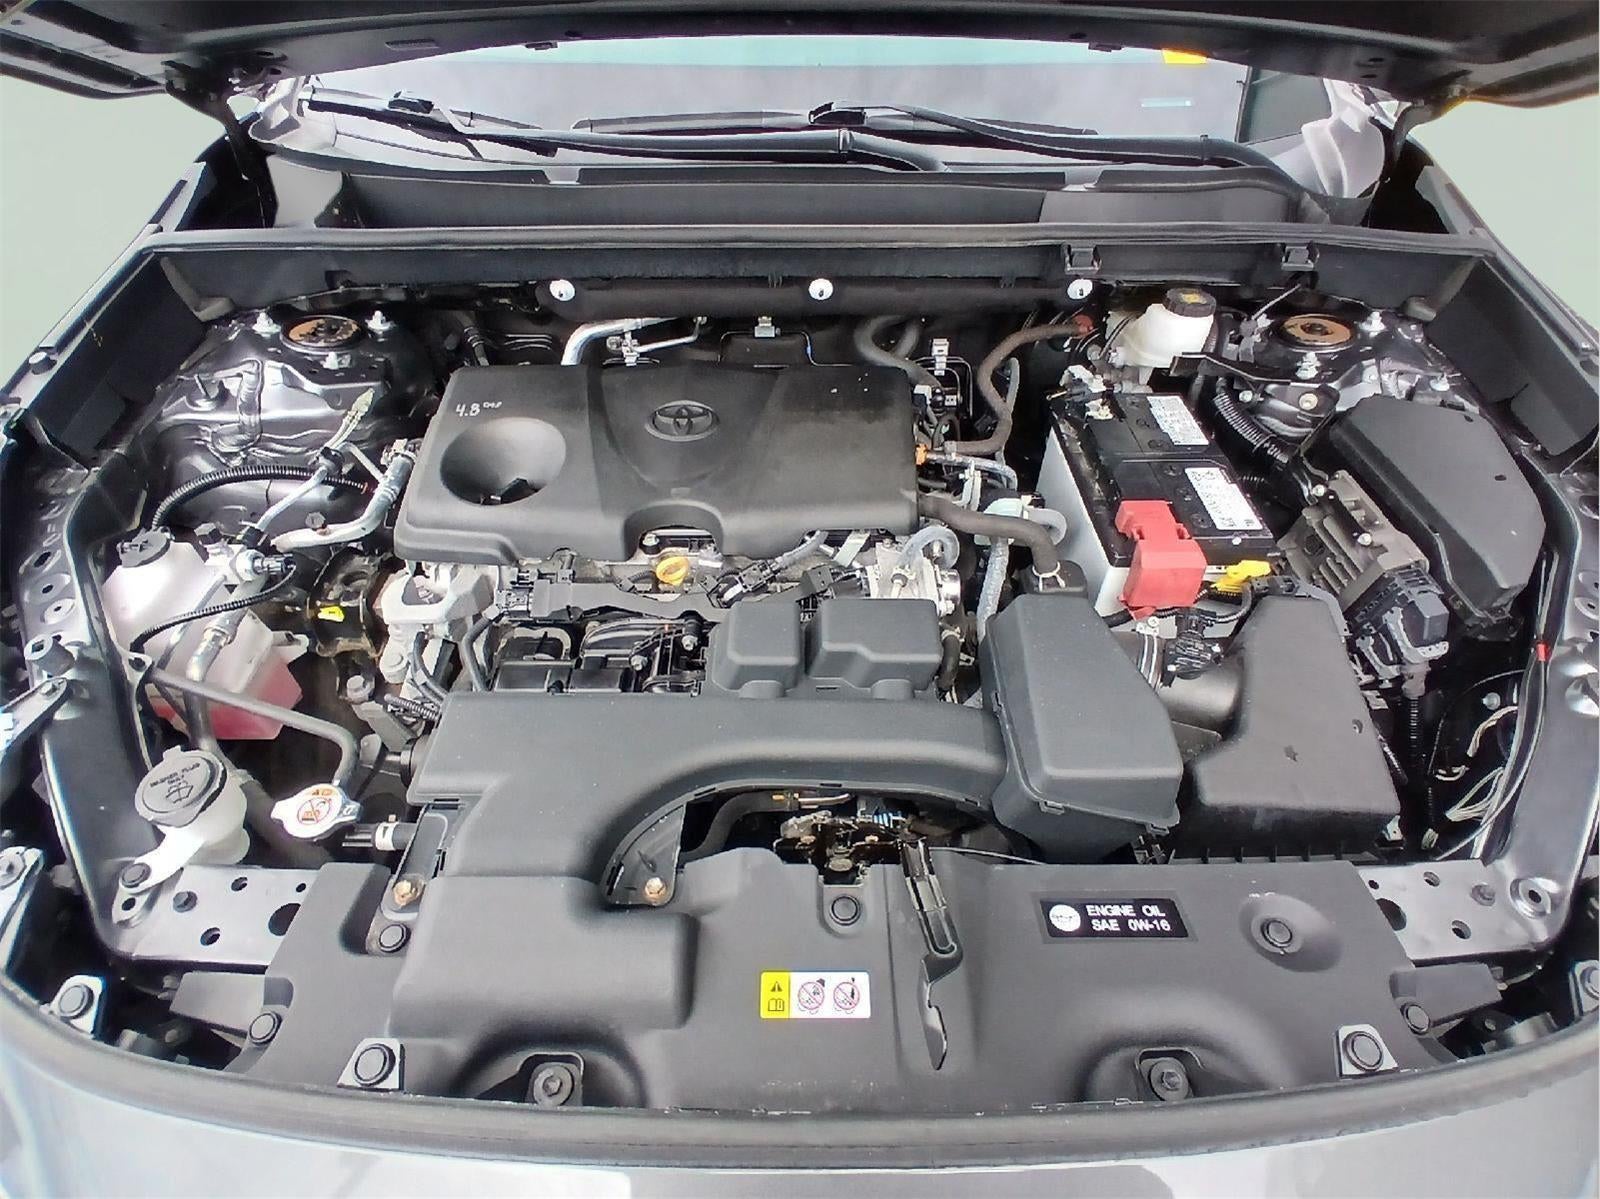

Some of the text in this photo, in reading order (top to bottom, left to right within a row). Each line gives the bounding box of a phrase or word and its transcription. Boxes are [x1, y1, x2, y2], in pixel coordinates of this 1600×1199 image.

[456, 403, 480, 416] 4.8
[1085, 905, 1166, 916] ENGINE OIL
[1092, 918, 1171, 931] SAE 0W-16
